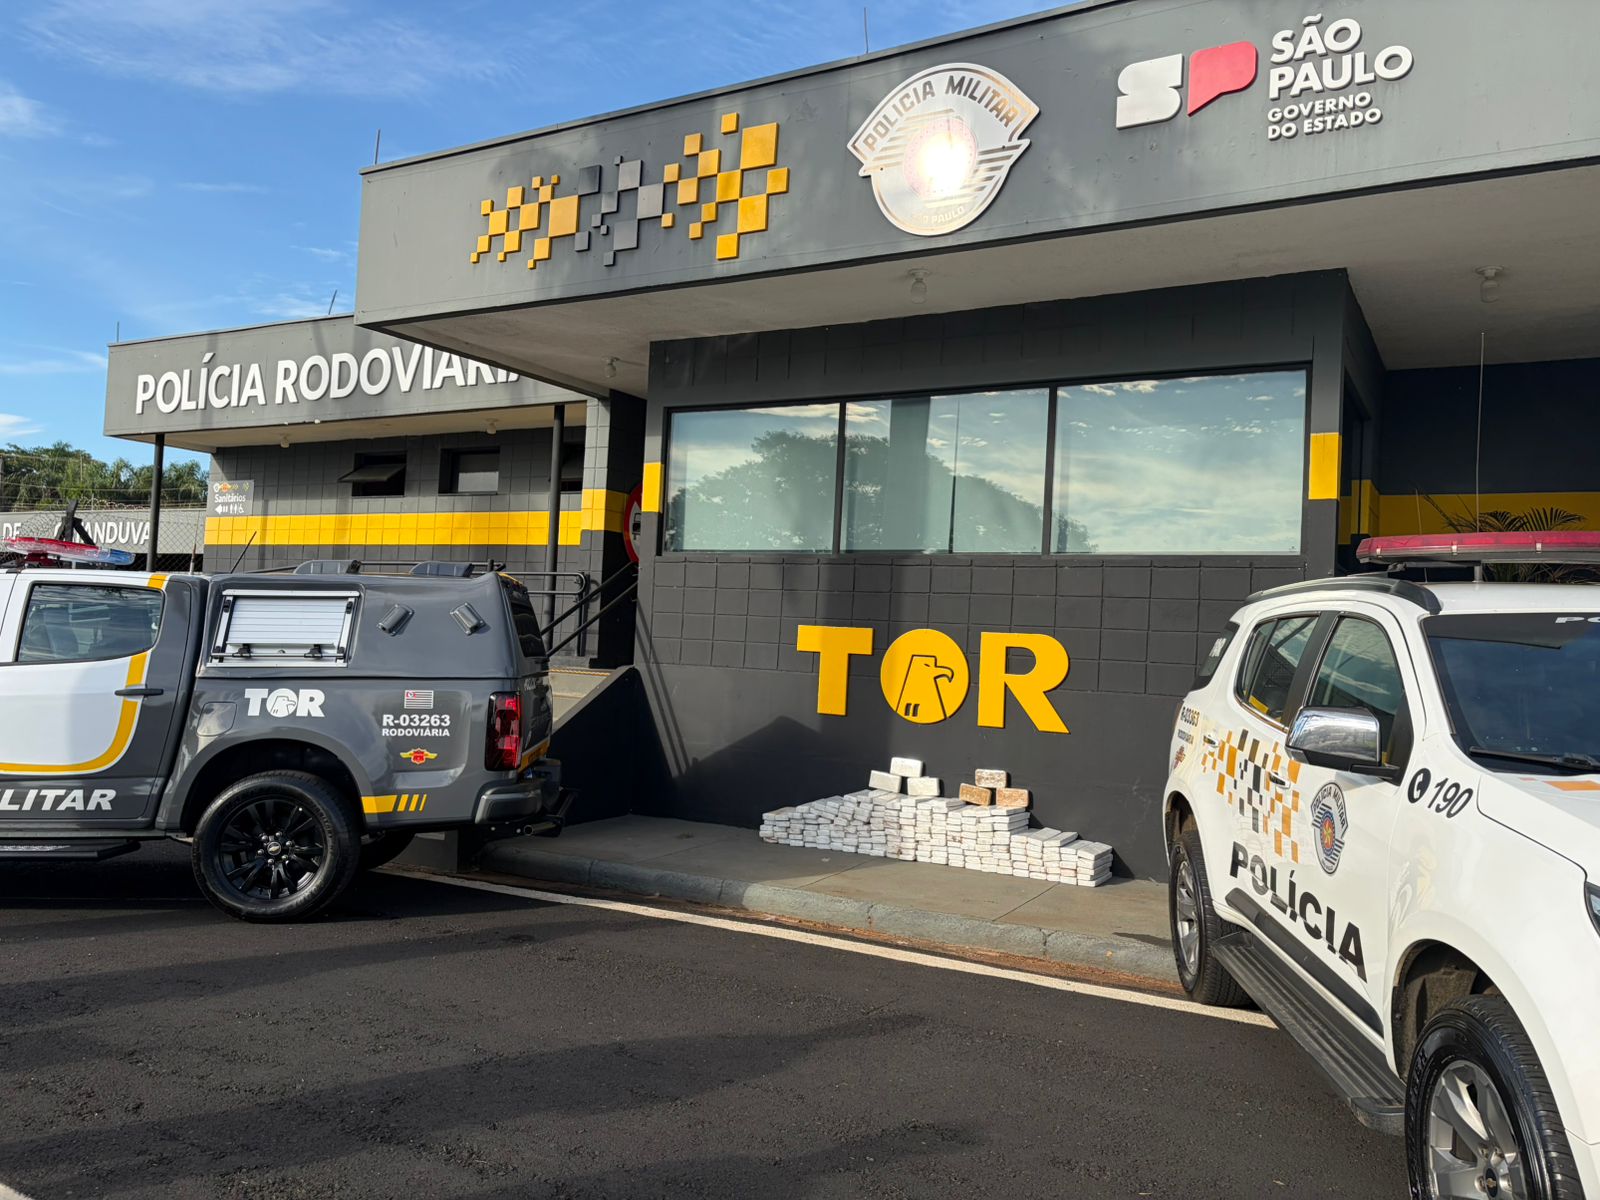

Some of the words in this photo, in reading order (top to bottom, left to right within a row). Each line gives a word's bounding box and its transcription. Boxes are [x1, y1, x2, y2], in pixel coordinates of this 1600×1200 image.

[1270, 13, 1361, 63] SÃO
[1269, 45, 1413, 100] PAULO
[863, 80, 936, 152] POLICIA
[945, 75, 1019, 127] MILITAR
[1267, 92, 1372, 122] GOVERNO
[1267, 123, 1298, 140] DO
[1303, 108, 1382, 134] ESTADO
[136, 352, 266, 414] POLÍCIA
[214, 492, 247, 503] Sanitários
[797, 624, 1071, 734] TOR
[244, 688, 326, 718] TOR
[382, 714, 451, 727] R-03263
[381, 727, 451, 737] RODOVIÁRIA
[0, 789, 117, 811] LITAR
[1427, 777, 1474, 818] 190
[1229, 841, 1368, 984] POLÍCIA
